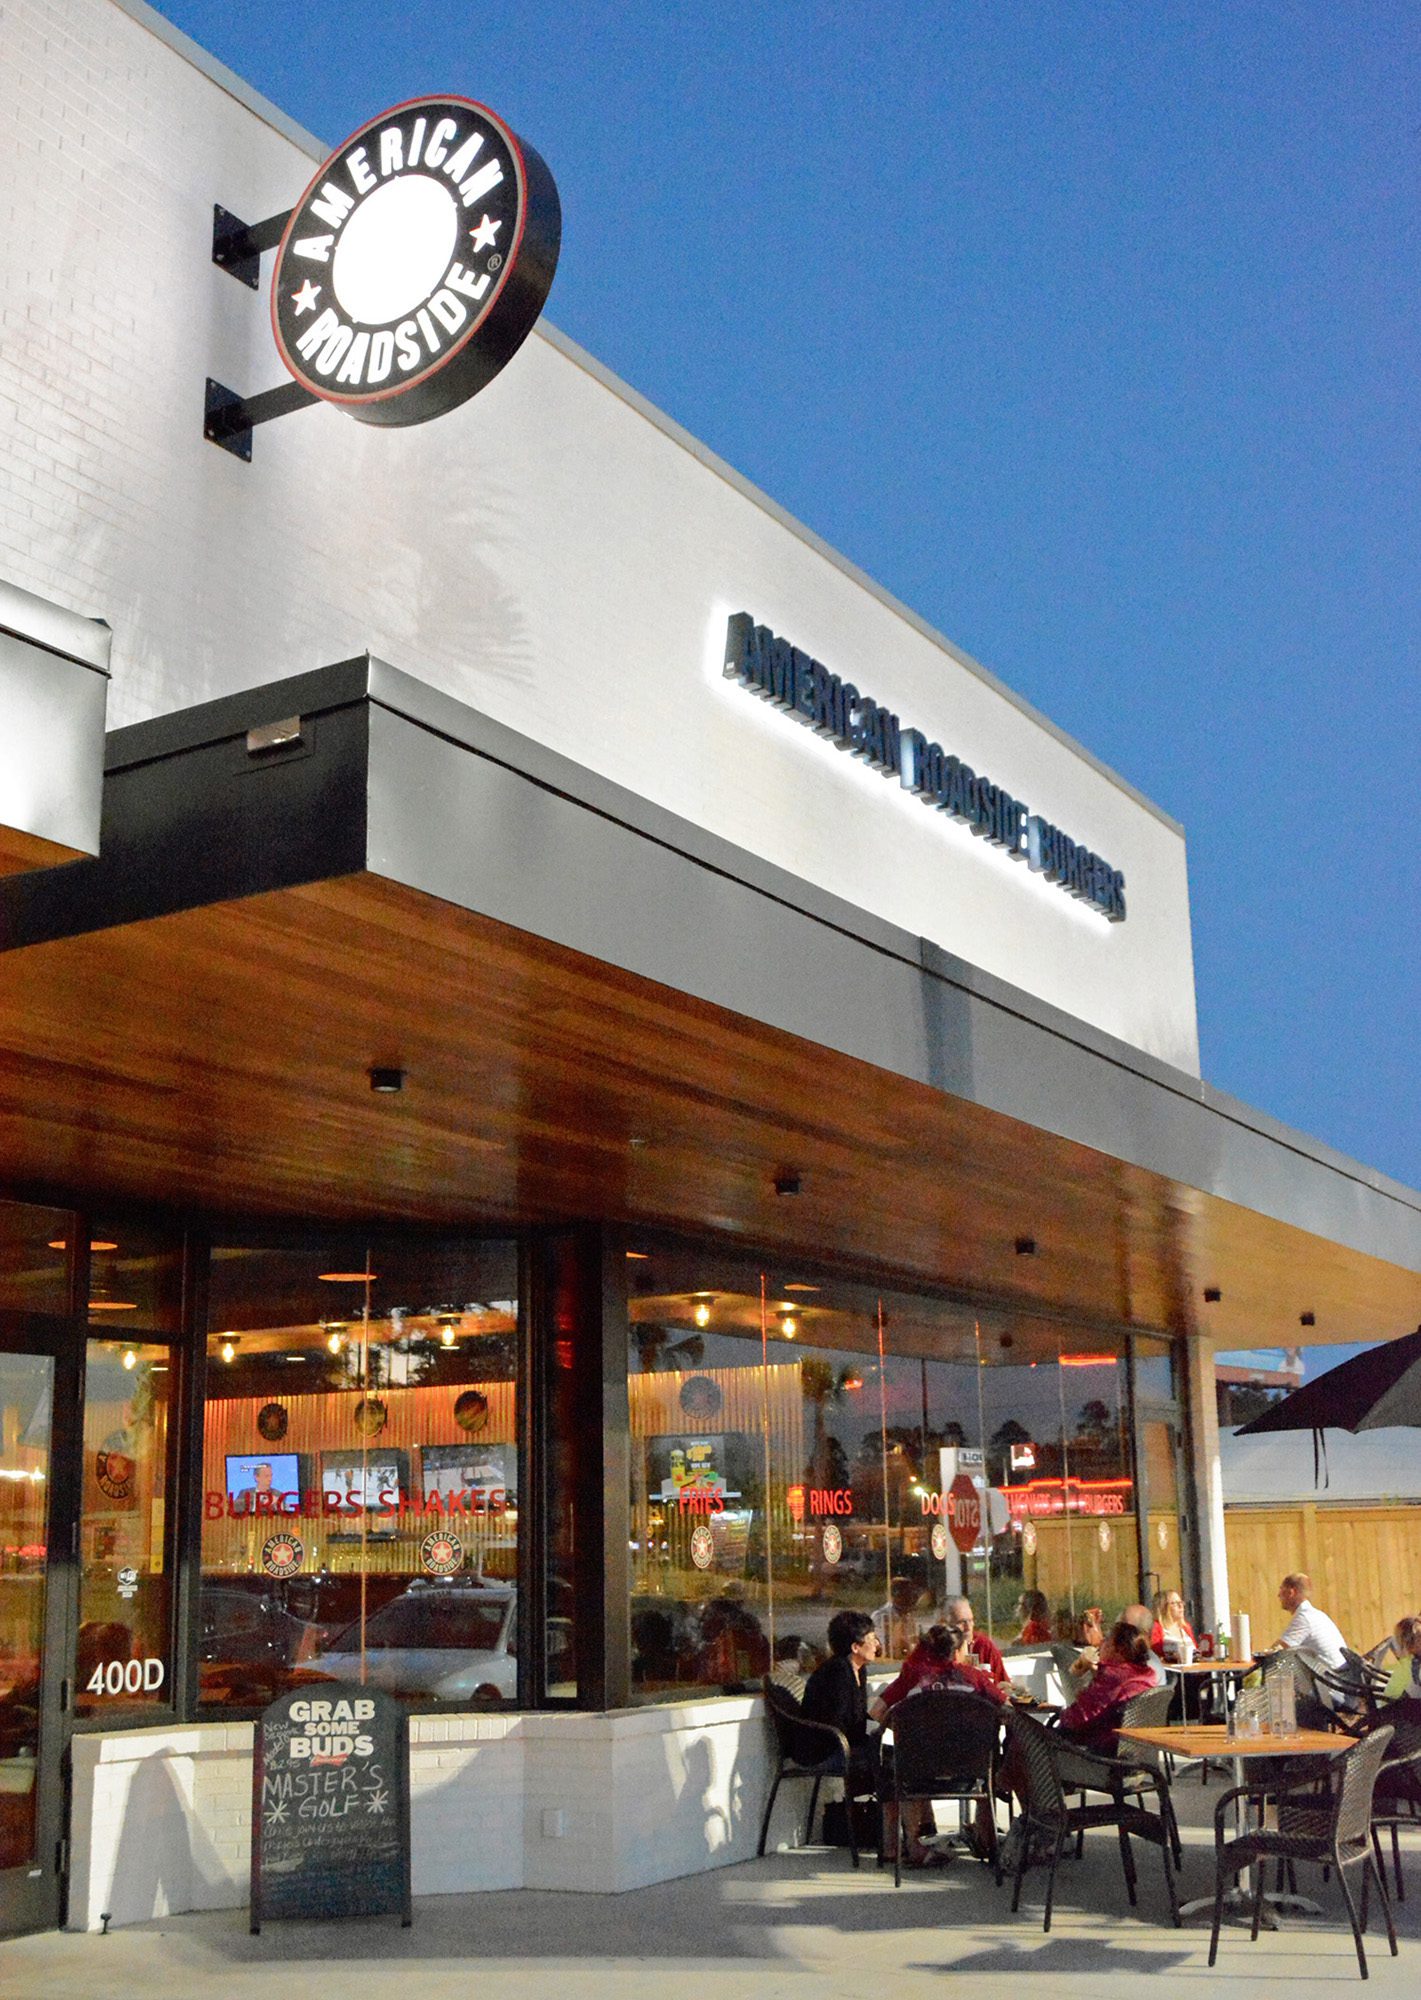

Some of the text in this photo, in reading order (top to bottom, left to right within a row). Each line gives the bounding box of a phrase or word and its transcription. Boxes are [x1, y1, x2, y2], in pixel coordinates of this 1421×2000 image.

[293, 117, 504, 262] AMERICAN
[295, 261, 491, 385] ROADSIDE
[204, 1488, 507, 1520] BURGERS SHAKES
[679, 1487, 725, 1515] FRIES
[810, 1487, 853, 1515] RINGS
[86, 1658, 165, 1696] 400D
[289, 1699, 376, 1722] GRAB
[304, 1721, 360, 1736] SOME
[290, 1735, 374, 1758] BUDS
[261, 1761, 384, 1805] MASTER'S
[298, 1794, 360, 1818] GOLF
